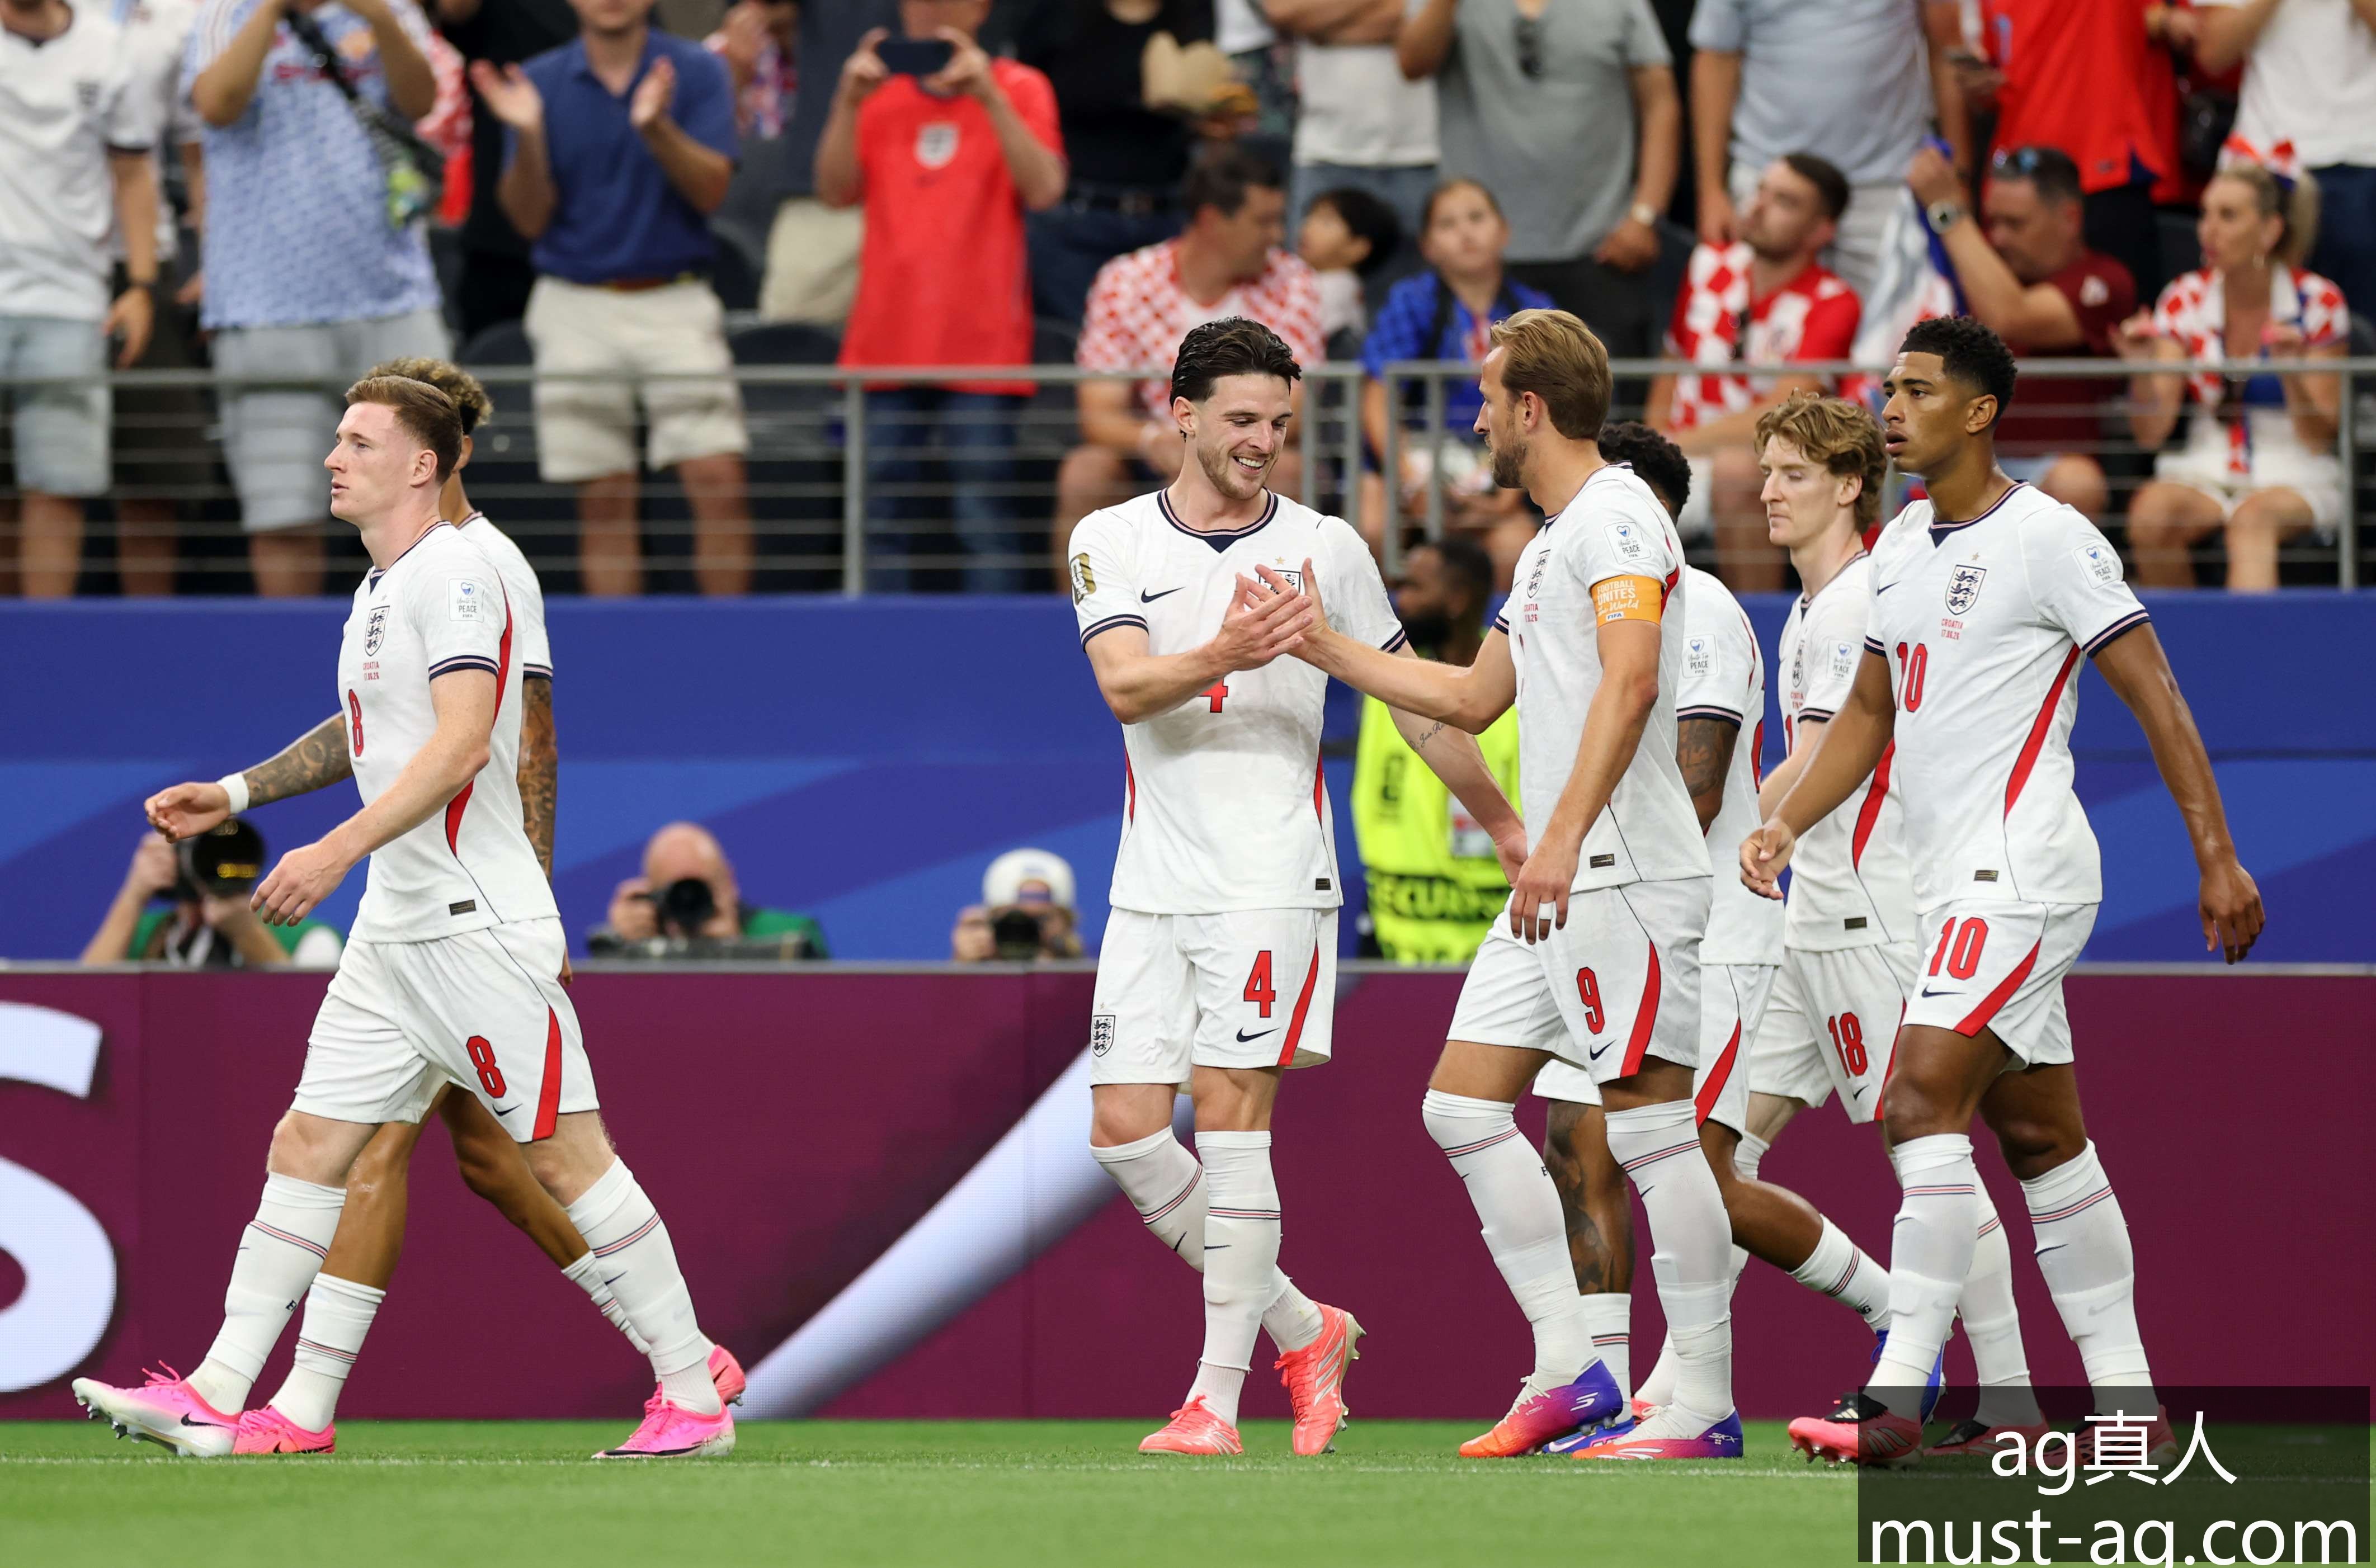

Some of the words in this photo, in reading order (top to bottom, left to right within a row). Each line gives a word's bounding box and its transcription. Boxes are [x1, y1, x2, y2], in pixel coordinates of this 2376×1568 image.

[1622, 544, 1640, 554] PEACE
[1597, 580, 1635, 596] FOOTBALL
[1597, 588, 1636, 606] UNITES
[459, 605, 477, 613] PEACE
[1609, 599, 1639, 611] World
[1941, 618, 1963, 629] CROATIA
[1690, 661, 1708, 669] PEACE
[1833, 665, 1849, 674] PEACE
[1896, 642, 1928, 713] 10
[348, 688, 364, 757] 8
[1927, 916, 1989, 980] 10
[1243, 950, 1276, 1018] 4
[1576, 966, 1605, 1035] 9
[1828, 1012, 1868, 1079] 18
[466, 1035, 507, 1098] 8
